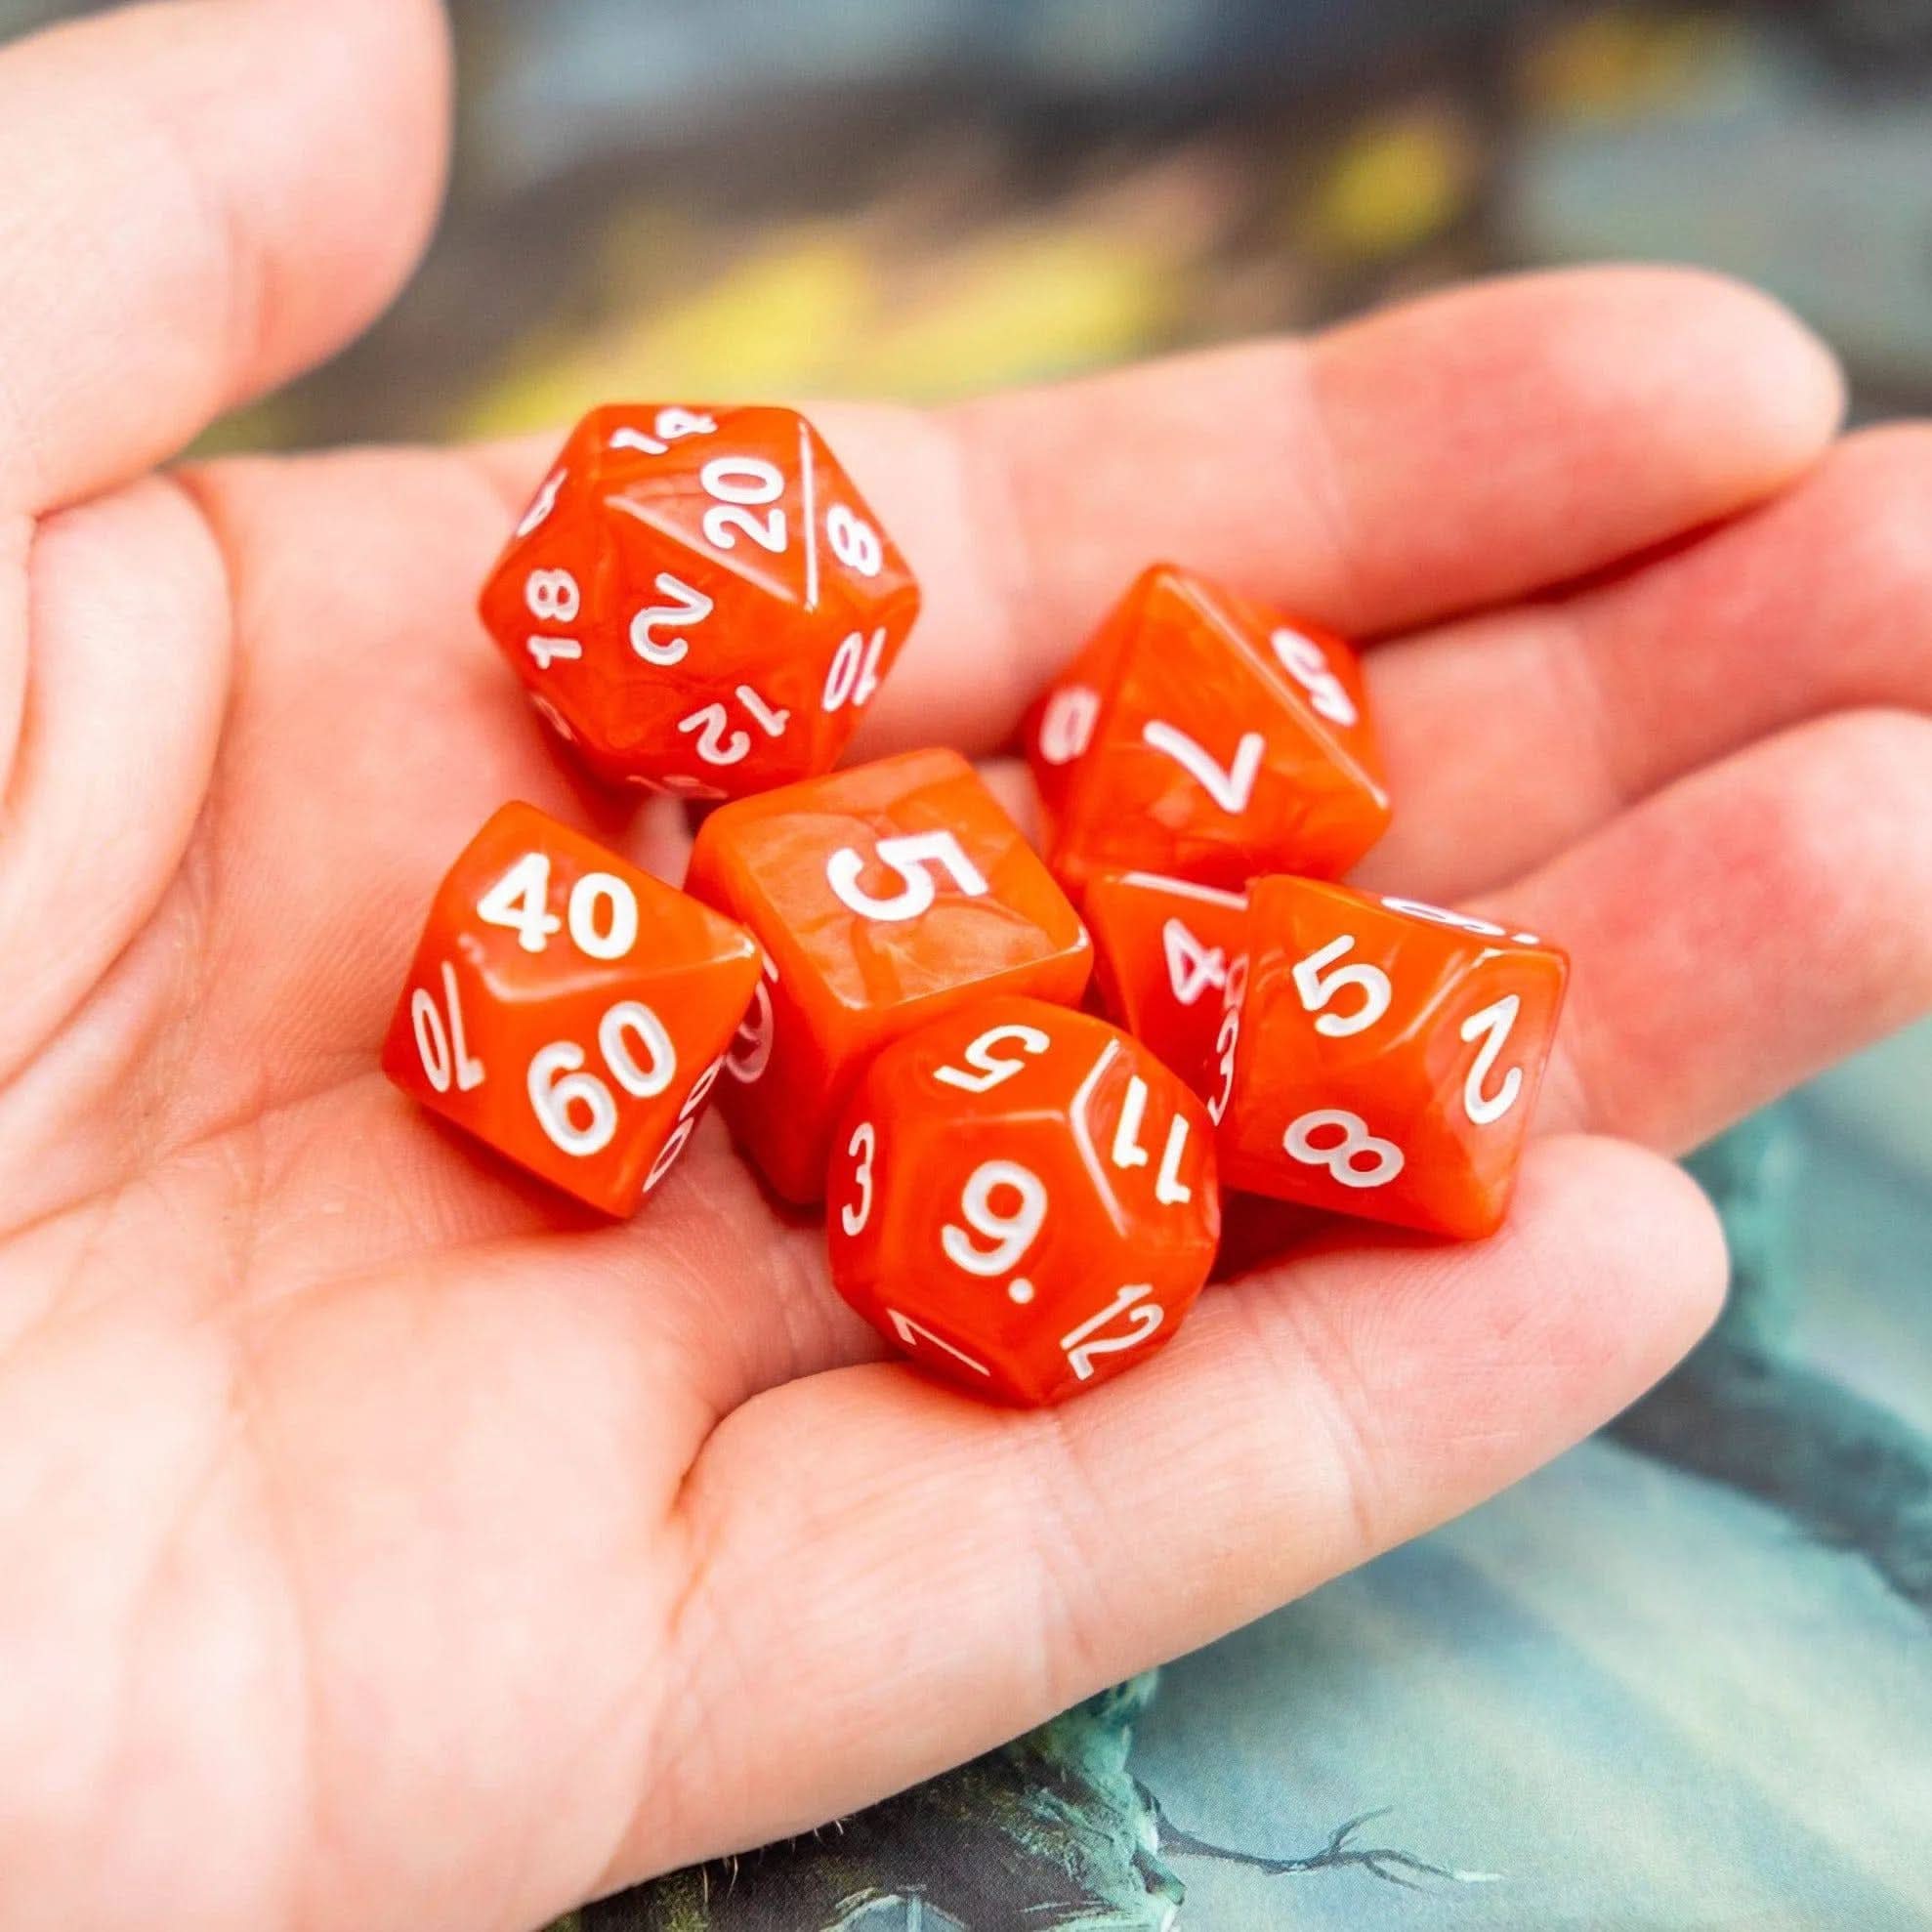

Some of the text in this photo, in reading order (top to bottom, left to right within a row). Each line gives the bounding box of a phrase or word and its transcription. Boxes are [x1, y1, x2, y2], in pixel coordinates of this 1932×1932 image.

[609, 407, 718, 456] 14
[699, 456, 788, 554] 20
[825, 503, 884, 578] 8
[525, 567, 583, 670] 18
[629, 571, 714, 666] 2
[821, 628, 886, 713] 10
[677, 684, 791, 766] 12
[1142, 720, 1266, 814] 7
[476, 851, 640, 961] 40
[825, 829, 990, 923] 5
[1162, 917, 1230, 1006] 4
[1291, 934, 1392, 1037] 5
[526, 1000, 677, 1156] 60
[933, 1023, 1052, 1093] 5
[1460, 993, 1527, 1126] 2
[841, 1121, 875, 1238] 3
[1112, 1074, 1192, 1205] 11
[1282, 1109, 1405, 1189] 8
[1061, 1282, 1164, 1380] 12
